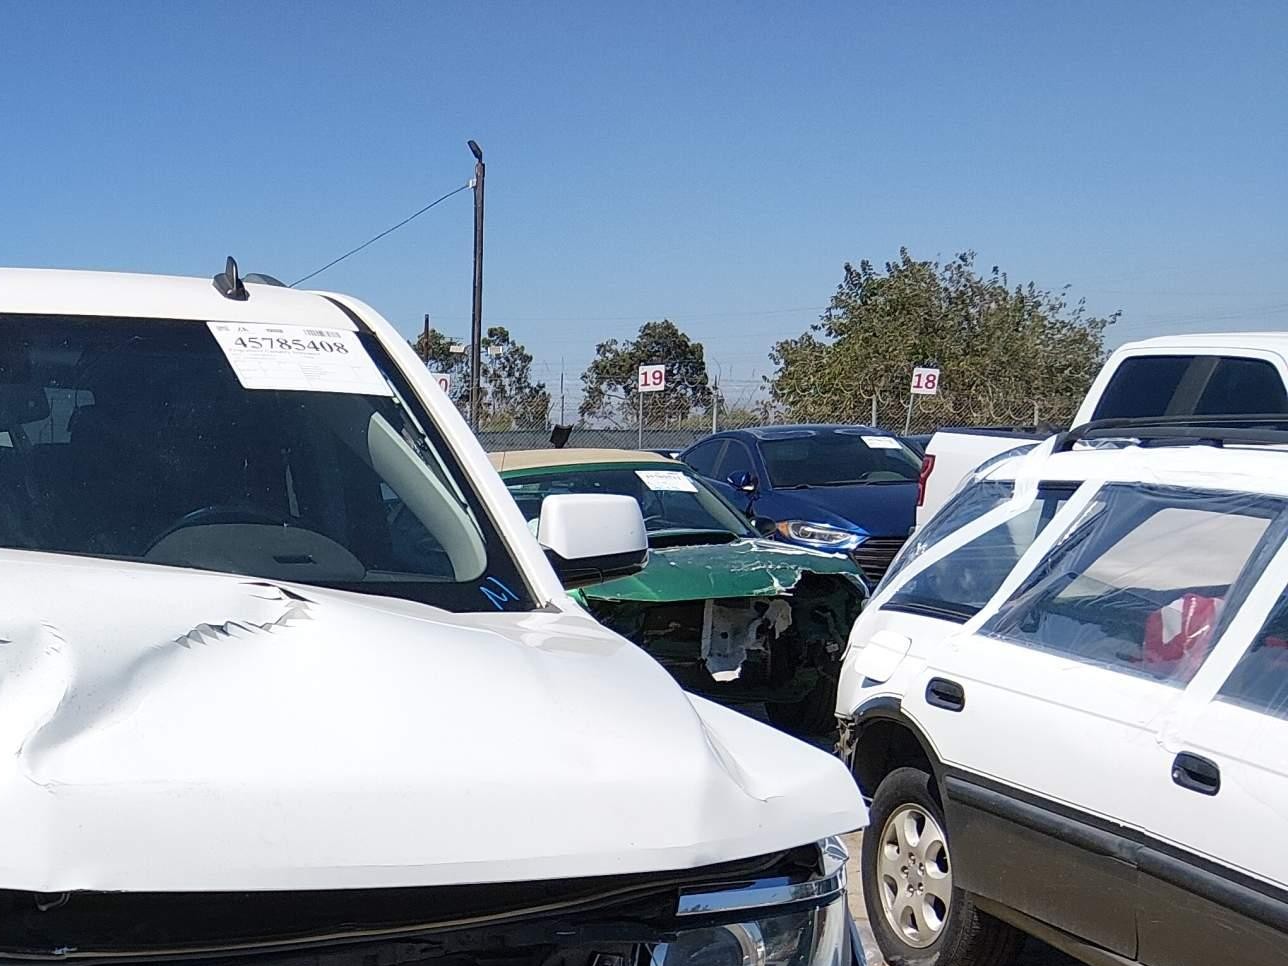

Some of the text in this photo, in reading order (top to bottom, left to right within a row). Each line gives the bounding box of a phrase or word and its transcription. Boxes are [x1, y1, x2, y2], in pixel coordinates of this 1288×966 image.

[234, 336, 349, 354] 45785408
[640, 370, 663, 386] 19
[912, 373, 937, 389] 18
